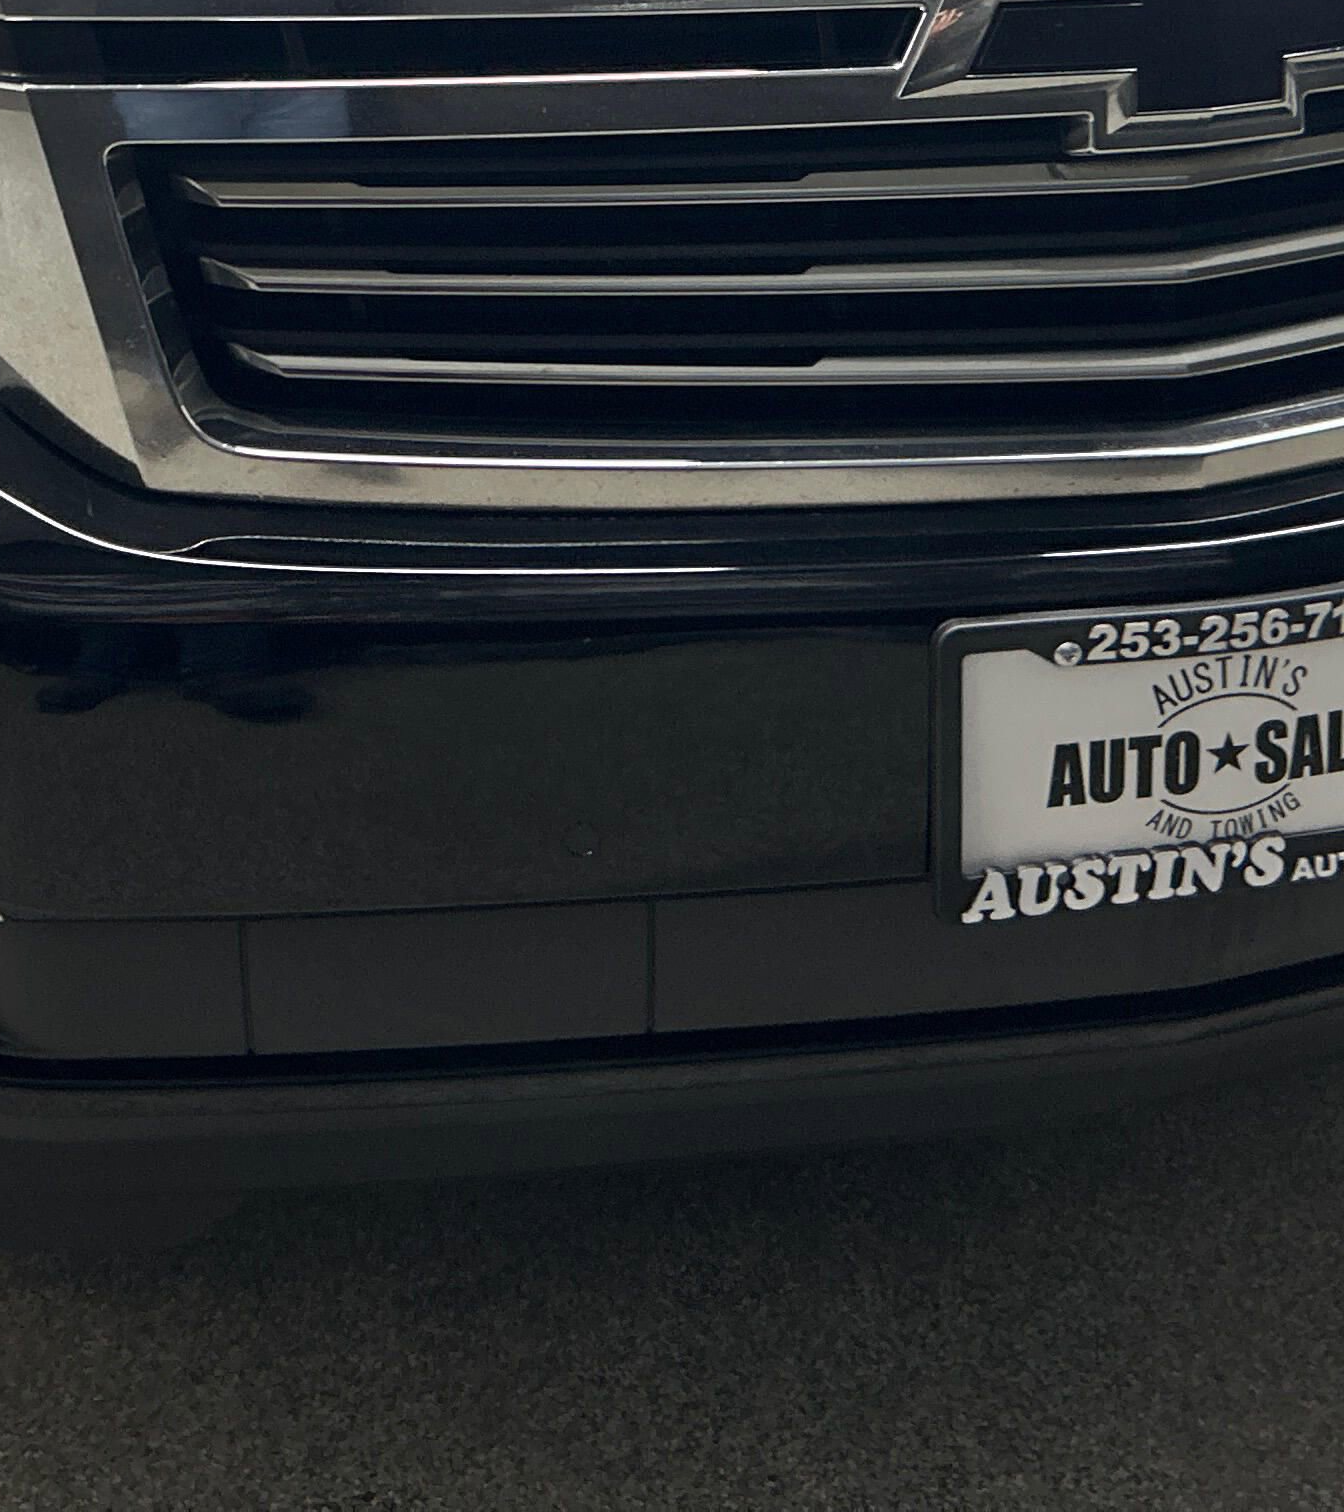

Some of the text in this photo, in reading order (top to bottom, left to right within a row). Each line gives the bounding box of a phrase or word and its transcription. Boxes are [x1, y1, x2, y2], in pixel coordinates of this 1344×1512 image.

[1152, 652, 1308, 717] AUSTIN'S
[1046, 730, 1200, 809] AUTO
[1145, 791, 1301, 839] AND TOWING
[961, 835, 1287, 925] AUSTIN'S
